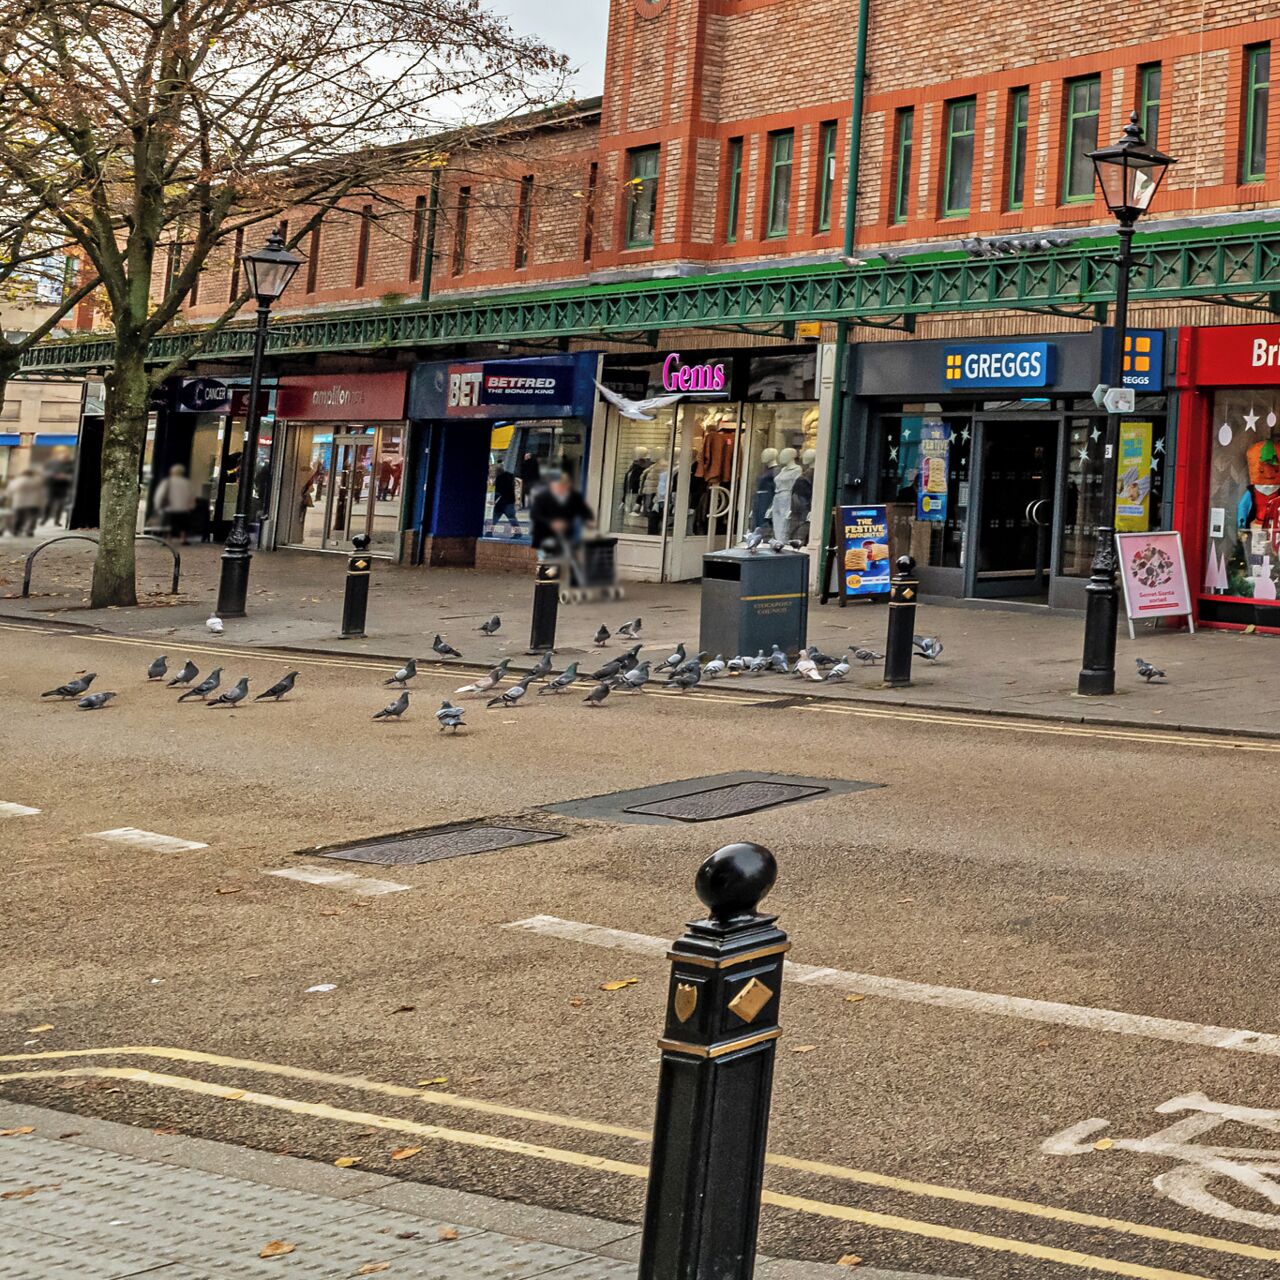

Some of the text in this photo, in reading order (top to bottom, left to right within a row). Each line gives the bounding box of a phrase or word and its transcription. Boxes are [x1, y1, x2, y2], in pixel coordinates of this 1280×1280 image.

[662, 352, 726, 392] Gems
[964, 351, 1042, 379] GREGGS
[487, 377, 556, 388] BETFRED
[1121, 375, 1150, 385] REGGS
[204, 387, 226, 401] CANCER
[450, 372, 483, 408] BET
[845, 524, 885, 533] FESTIVE
